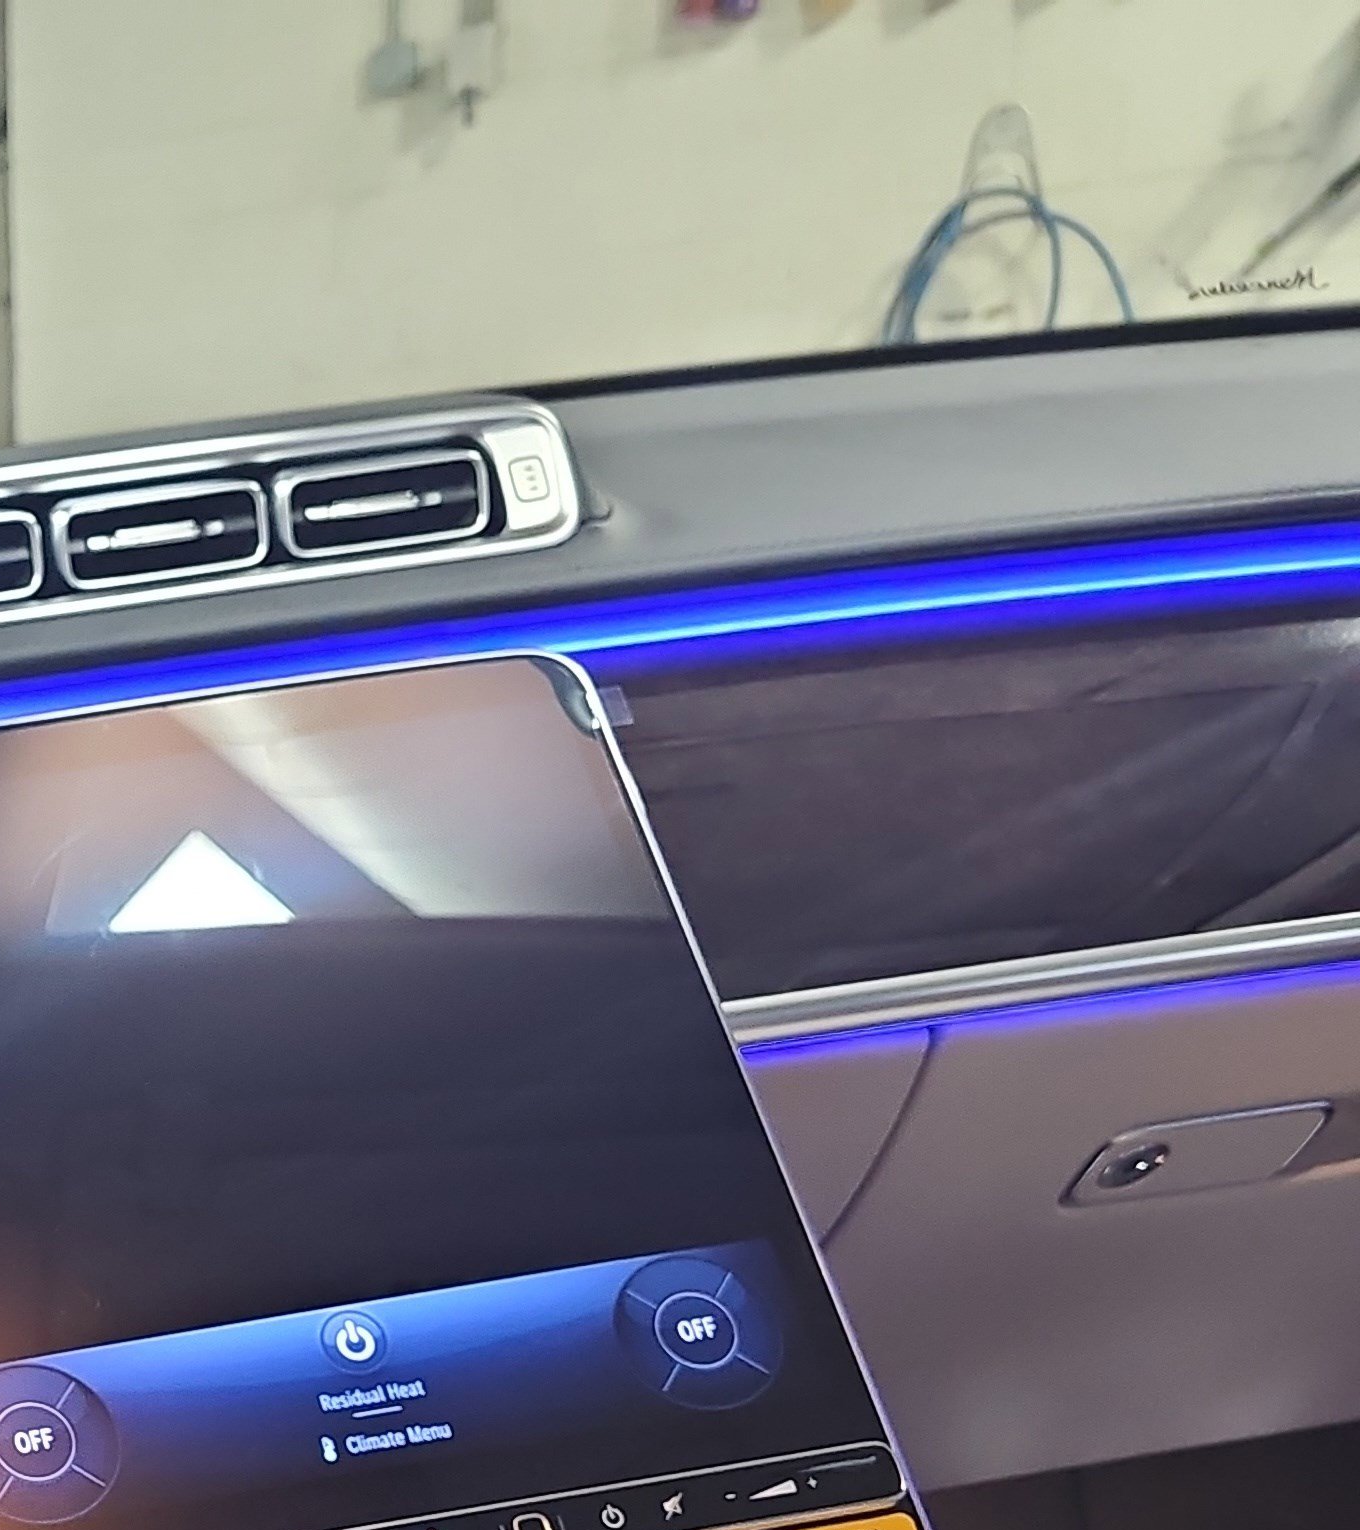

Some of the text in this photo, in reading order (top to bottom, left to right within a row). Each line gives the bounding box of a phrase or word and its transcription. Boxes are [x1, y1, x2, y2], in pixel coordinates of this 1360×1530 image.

[676, 1315, 717, 1343] OFF
[318, 1379, 427, 1412] Residual Heat
[14, 1427, 54, 1454] OFF
[345, 1423, 454, 1455] Climate Menu
